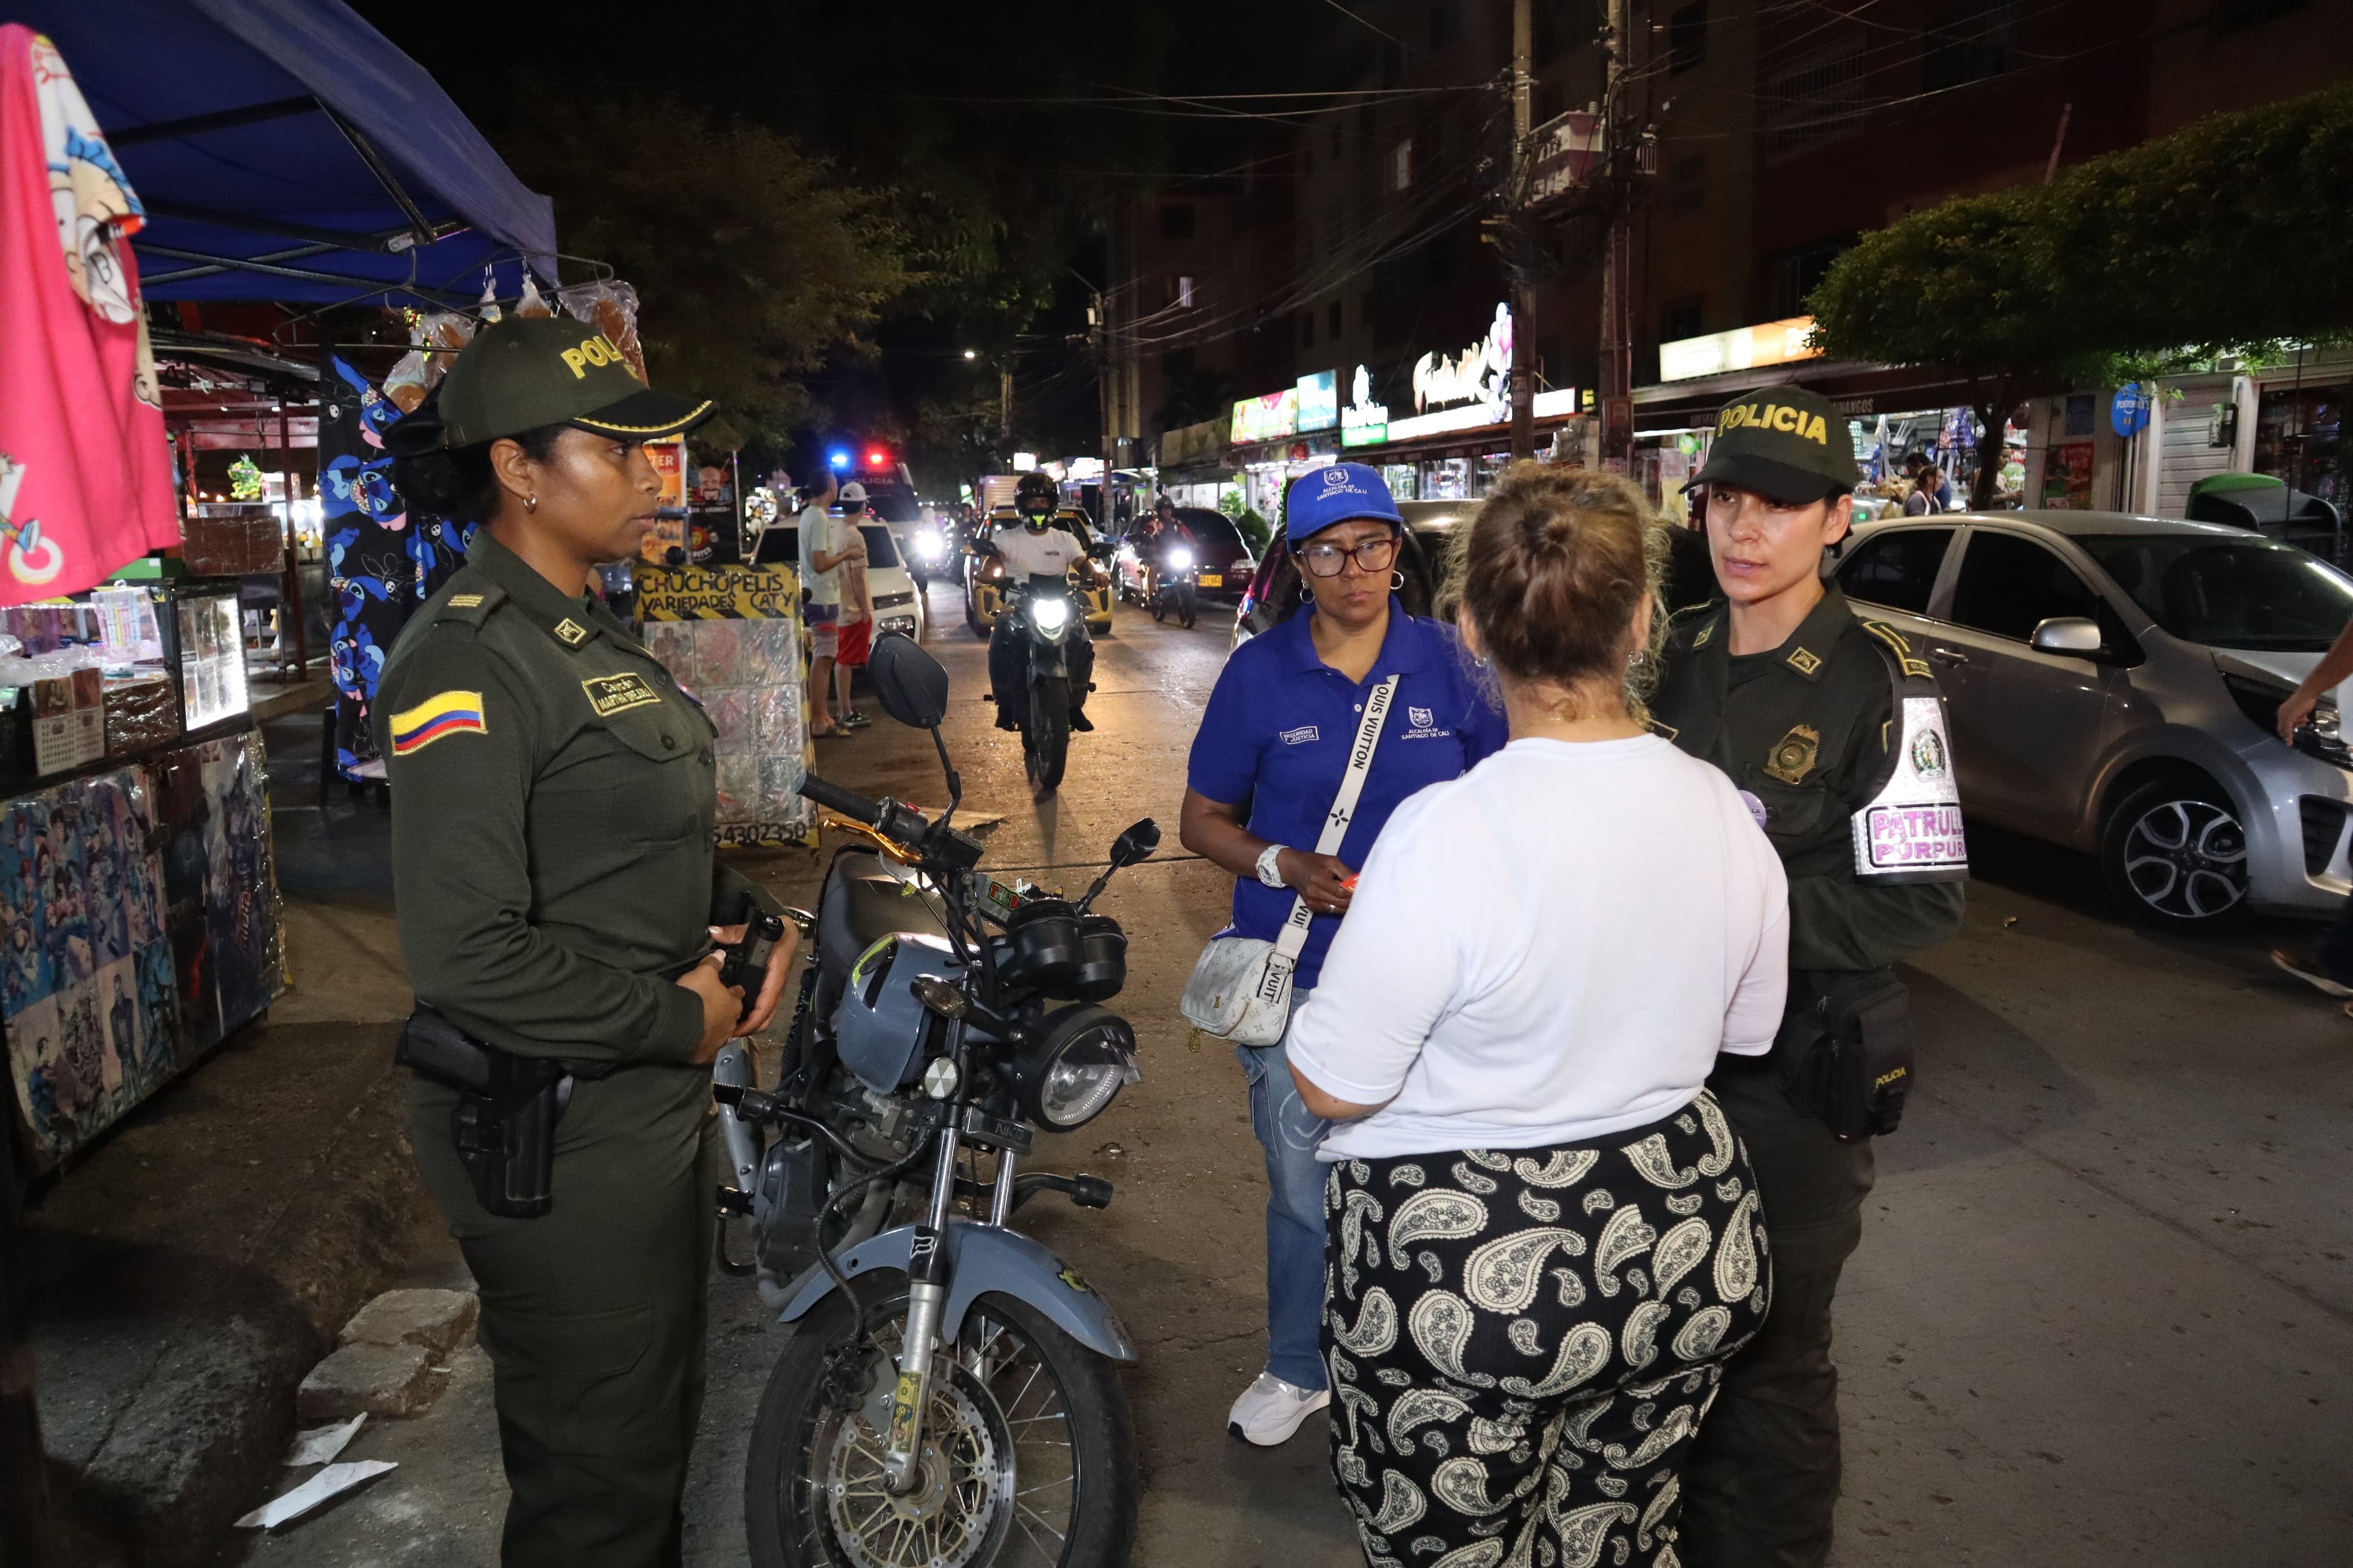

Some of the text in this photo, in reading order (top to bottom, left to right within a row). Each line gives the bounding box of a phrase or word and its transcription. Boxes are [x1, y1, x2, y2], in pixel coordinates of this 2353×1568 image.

[1717, 404, 1826, 444] POLICIA
[1317, 489, 1343, 501] SANTIAGO
[640, 570, 784, 594] CHUCHOPELIS
[641, 591, 794, 611] VARIEDADES CATY
[1283, 729, 1313, 738] SEGURIDAD
[1290, 733, 1315, 742] JUSTICIA
[1353, 717, 1380, 770] VUITTON
[713, 821, 807, 844] 54302350
[1873, 810, 1964, 840] PATRULL
[1874, 838, 1967, 862] PÚRPUR
[1293, 905, 1309, 928] VUI
[1264, 971, 1281, 1003] VUIT
[1875, 1067, 1906, 1089] POLICIA
